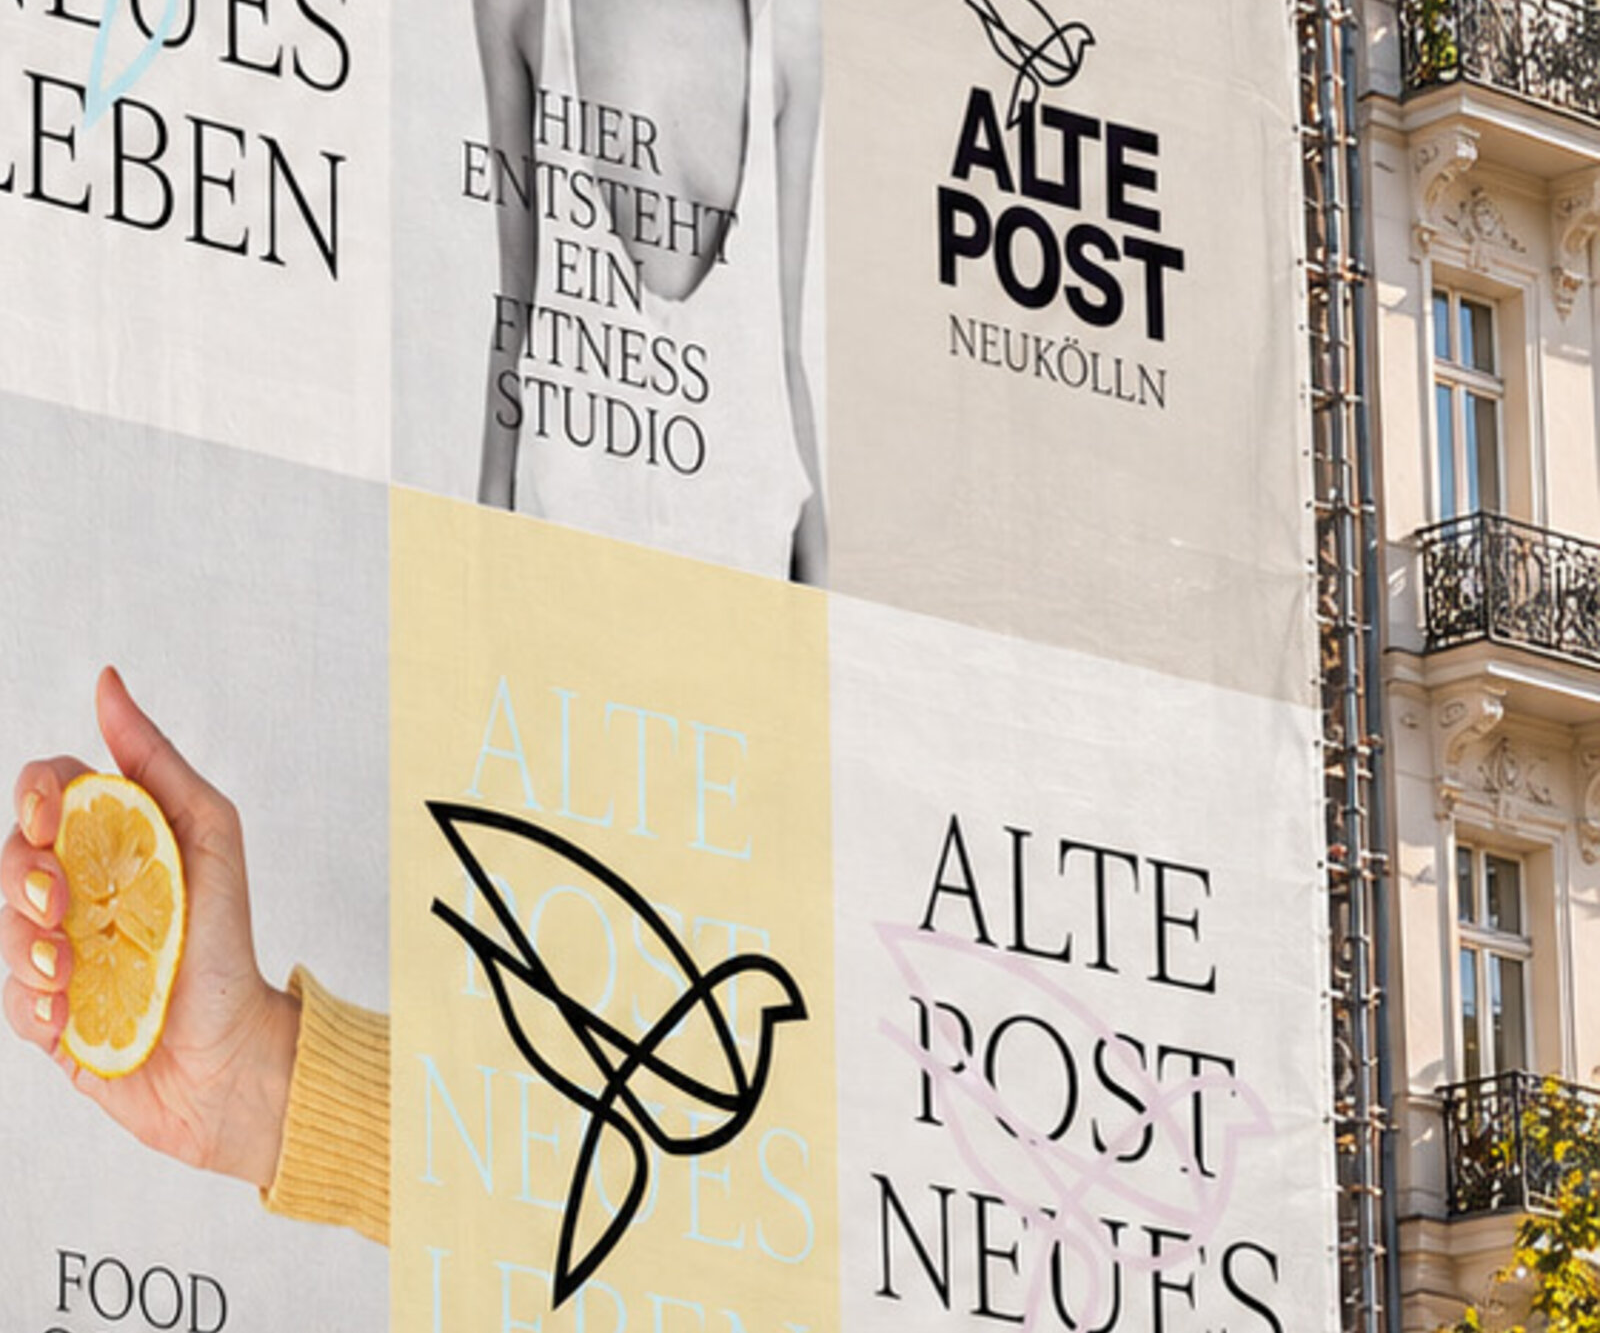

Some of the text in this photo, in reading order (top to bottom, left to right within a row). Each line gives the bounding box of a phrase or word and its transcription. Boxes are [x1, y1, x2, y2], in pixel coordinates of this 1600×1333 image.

[536, 88, 662, 176] HIER
[952, 86, 1162, 233] ALTE
[462, 139, 737, 265] ENTSTEHT
[938, 184, 1184, 343] POST
[554, 237, 644, 314] EIN
[492, 293, 711, 405] FITNESS
[948, 314, 1167, 409] NEUKÖLLN
[495, 369, 706, 476] STUDIO
[463, 675, 753, 861] ALTE
[918, 813, 1217, 995] ALTE
[910, 995, 1236, 1179] POST
